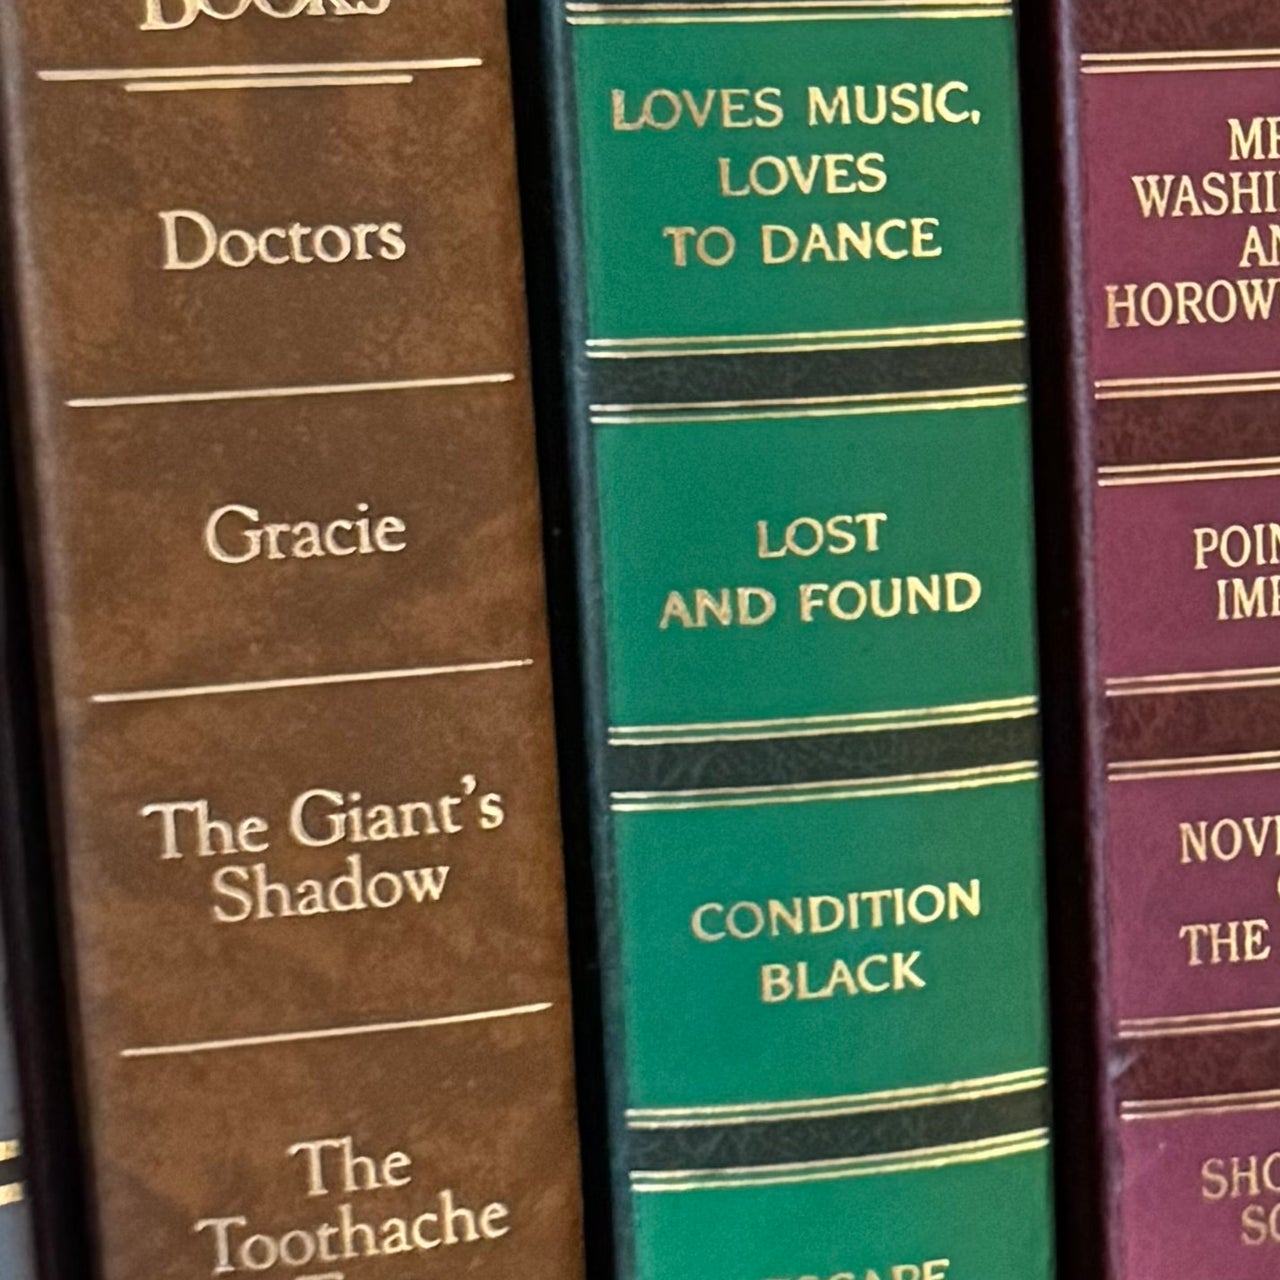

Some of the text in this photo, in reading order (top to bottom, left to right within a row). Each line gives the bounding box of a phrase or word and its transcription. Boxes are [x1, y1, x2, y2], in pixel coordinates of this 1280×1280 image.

[611, 81, 981, 132] LOVES MUSIC,
[718, 153, 887, 196] LOVES
[158, 209, 406, 271] Doctors
[662, 217, 943, 267] TO DANCE
[206, 502, 406, 564] Gracie
[756, 513, 888, 558] LOST
[659, 572, 982, 631] AND FOUND
[139, 774, 504, 860] The Giant's
[212, 854, 449, 922] Shadow
[691, 879, 981, 942] CONDITION
[1179, 918, 1272, 967] THE
[760, 951, 926, 1003] BLACK
[287, 1136, 411, 1196] The
[193, 1190, 509, 1275] Toothache
